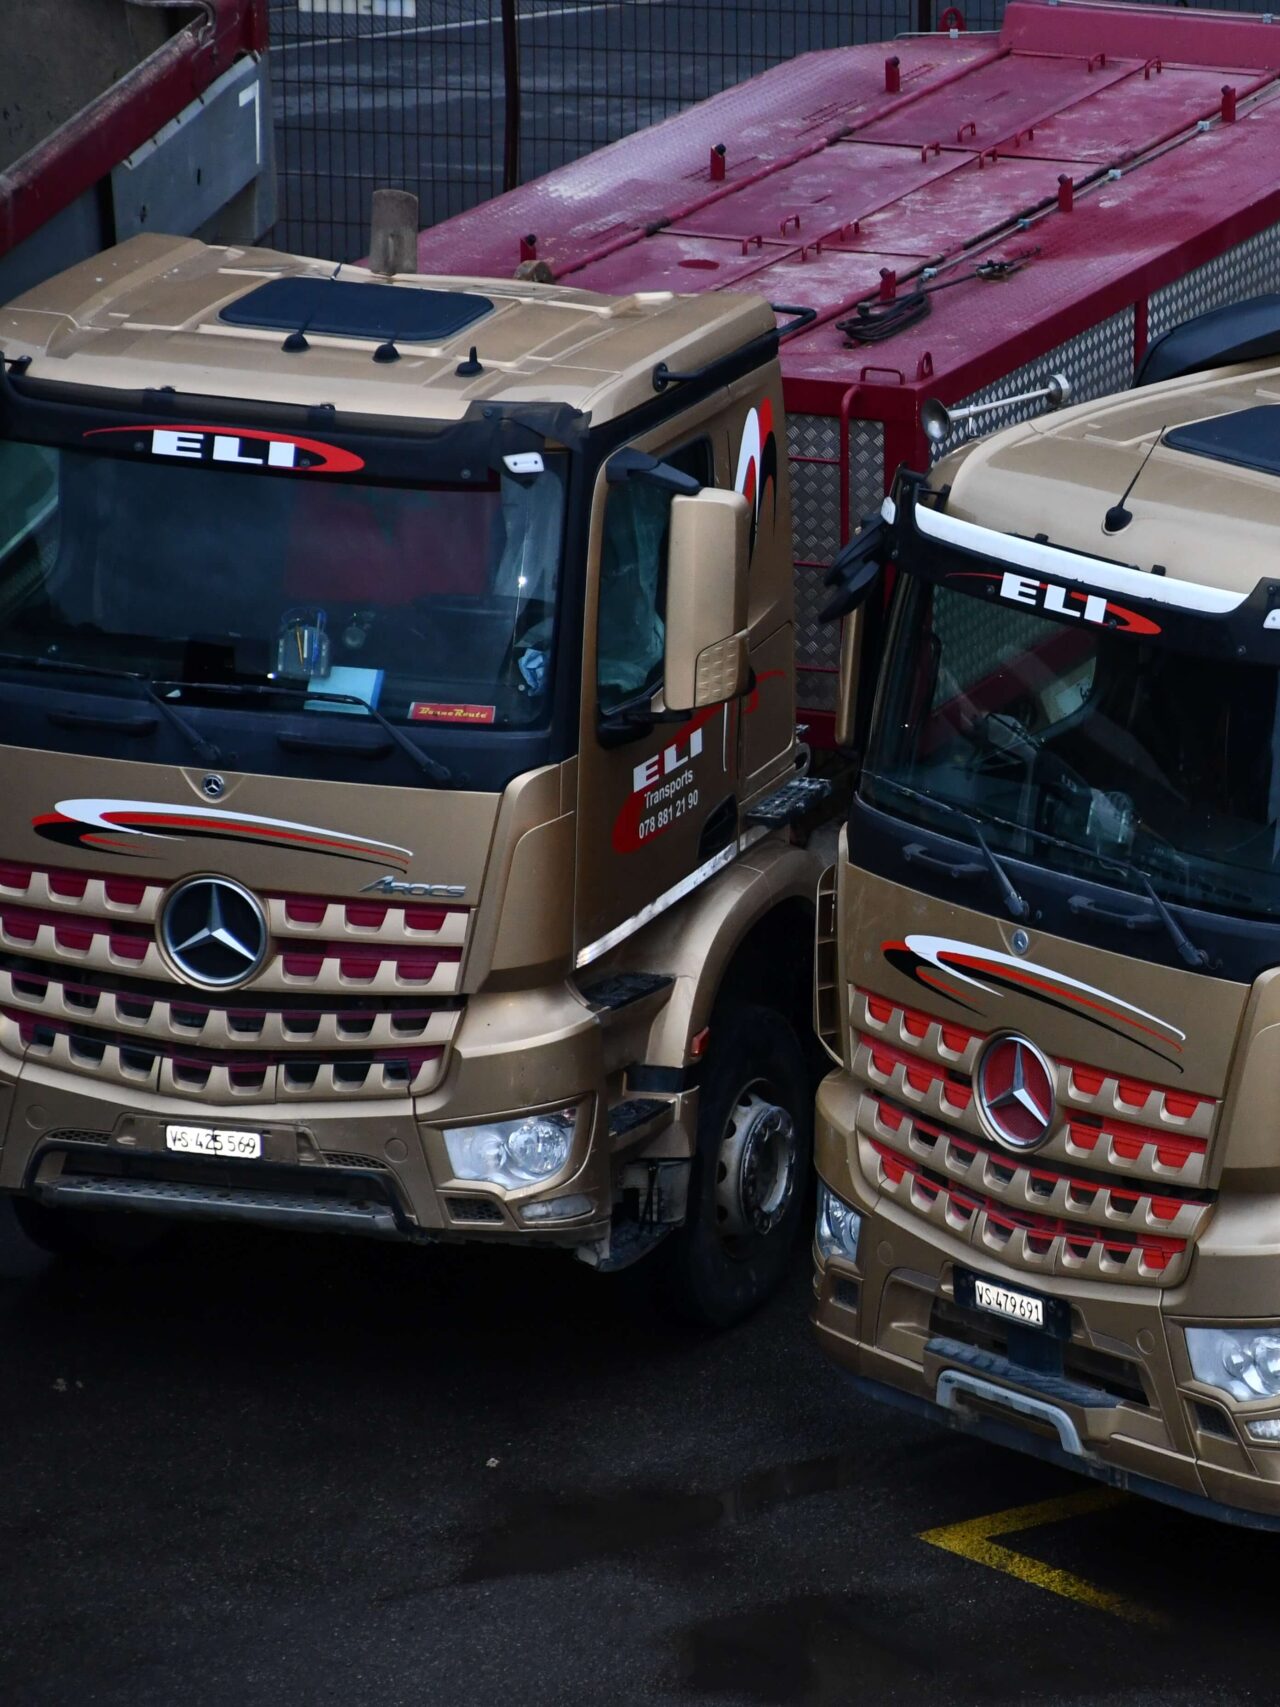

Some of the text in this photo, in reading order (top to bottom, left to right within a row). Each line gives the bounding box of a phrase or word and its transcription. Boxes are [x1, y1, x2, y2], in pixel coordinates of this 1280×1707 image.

[152, 429, 296, 468] ELI
[1000, 571, 1108, 624] ELI
[633, 727, 703, 793] ELI
[638, 789, 699, 840] 078 881 21 90
[644, 769, 694, 809] Transports
